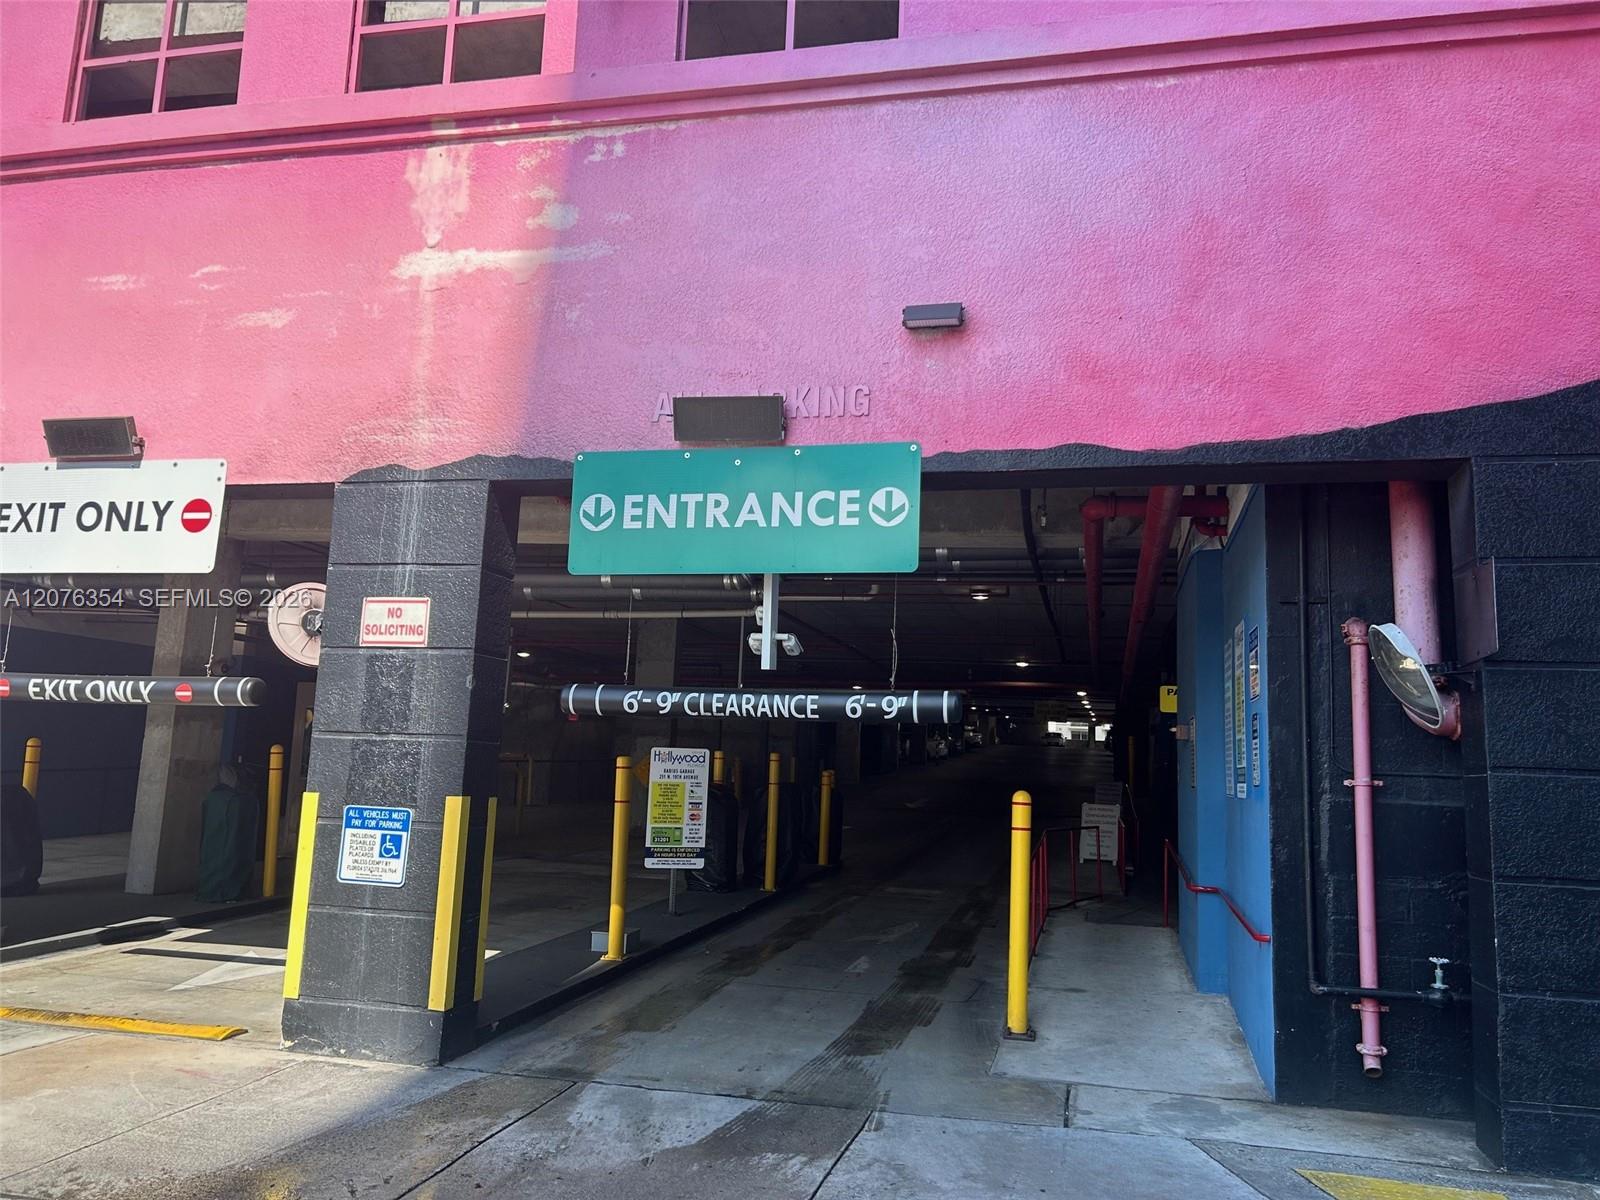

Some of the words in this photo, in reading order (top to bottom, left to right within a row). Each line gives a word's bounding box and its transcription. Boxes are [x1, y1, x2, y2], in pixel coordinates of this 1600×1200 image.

[622, 489, 860, 529] ENTRANCE
[0, 501, 66, 533] EXIT
[75, 501, 175, 533] ONLY
[387, 607, 403, 619] NO
[364, 624, 424, 636] SOLICITING
[27, 678, 85, 702] EXIT
[85, 678, 157, 703] ONLY
[683, 692, 819, 719] CLEARANCE
[653, 750, 707, 765] Hollywood
[348, 809, 360, 818] ALL
[363, 809, 389, 819] VEHICLES
[392, 811, 408, 820] MUST
[351, 818, 363, 827] PAY
[365, 819, 377, 828] FOR
[378, 820, 403, 829] PARKING
[350, 832, 377, 840] INCLUDING
